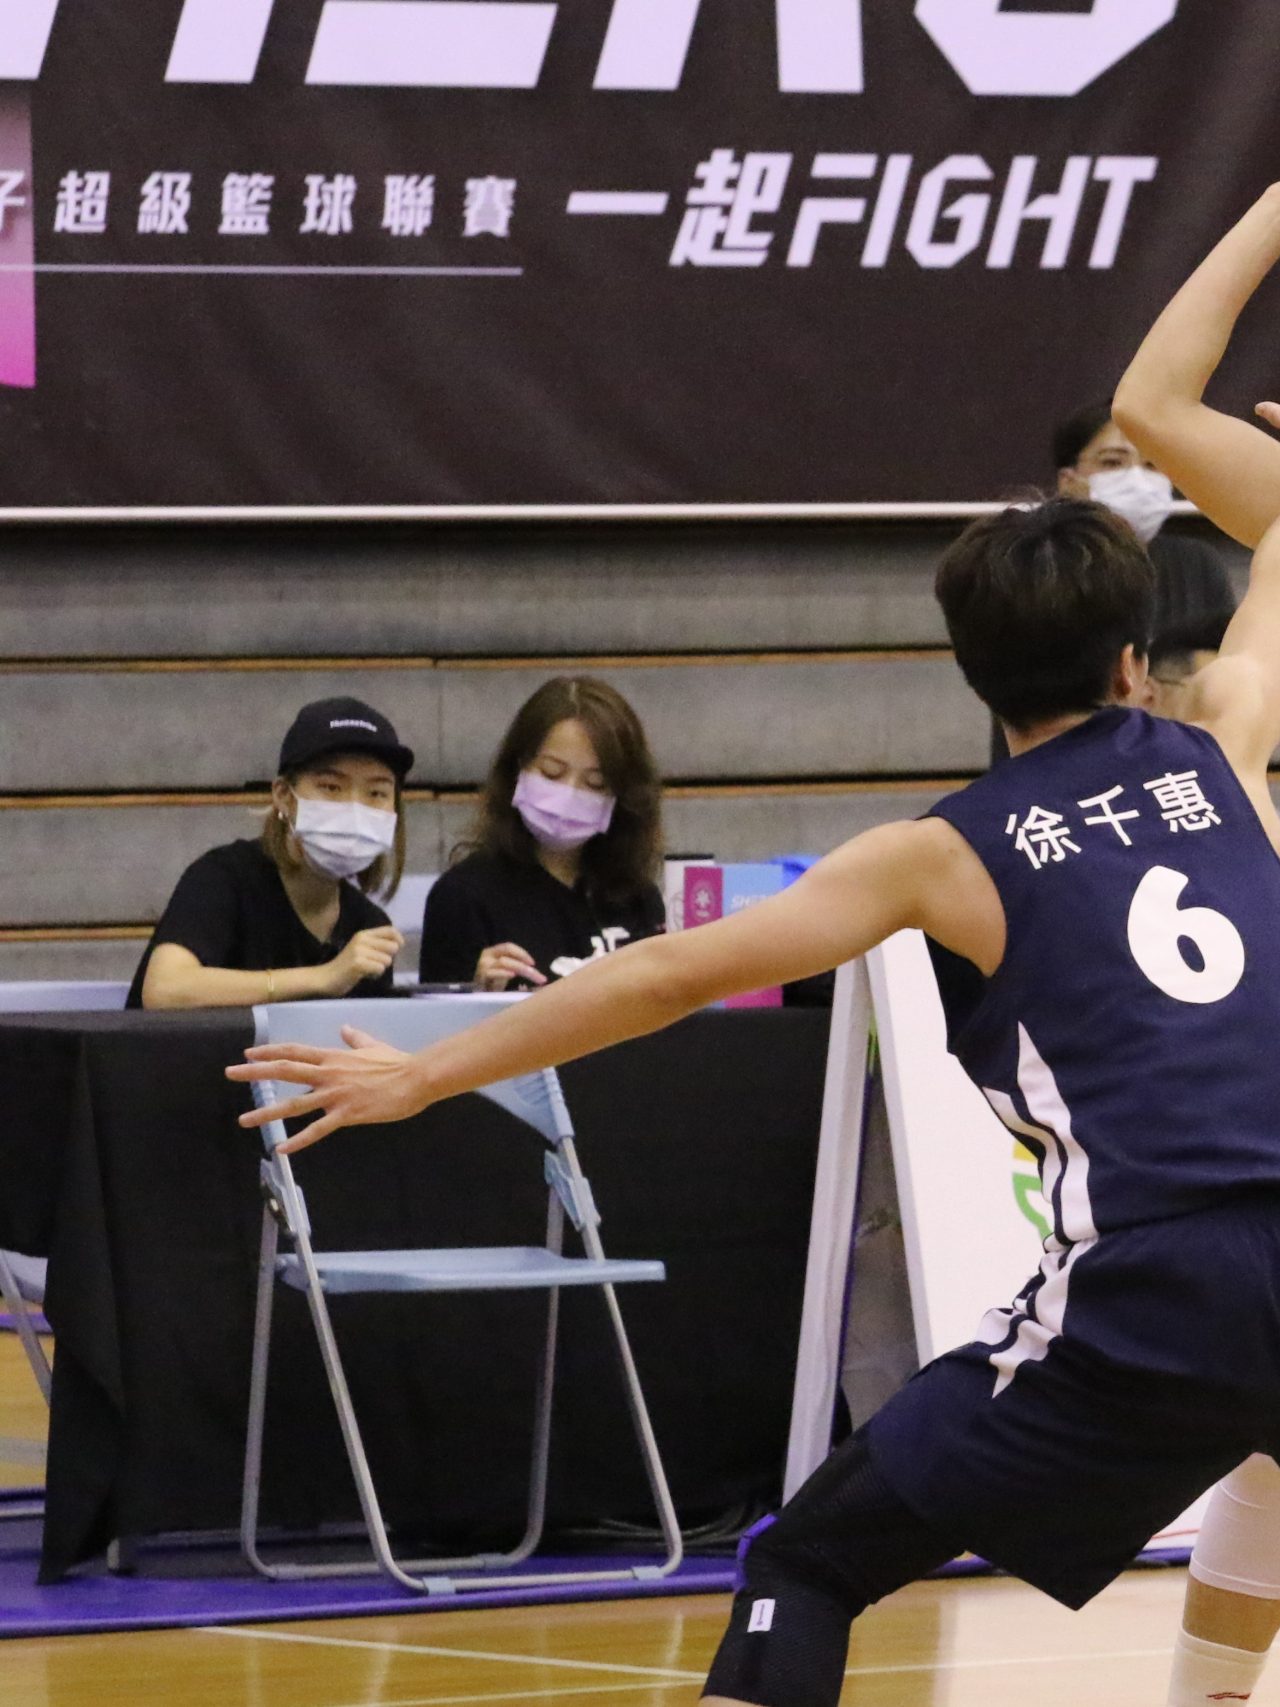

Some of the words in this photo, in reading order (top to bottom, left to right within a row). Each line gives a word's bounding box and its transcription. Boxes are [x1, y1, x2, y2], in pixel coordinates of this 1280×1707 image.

[566, 148, 1158, 269] 一起FIGHT
[1005, 769, 1222, 870] 徐千惠
[1128, 865, 1245, 1004] 6
